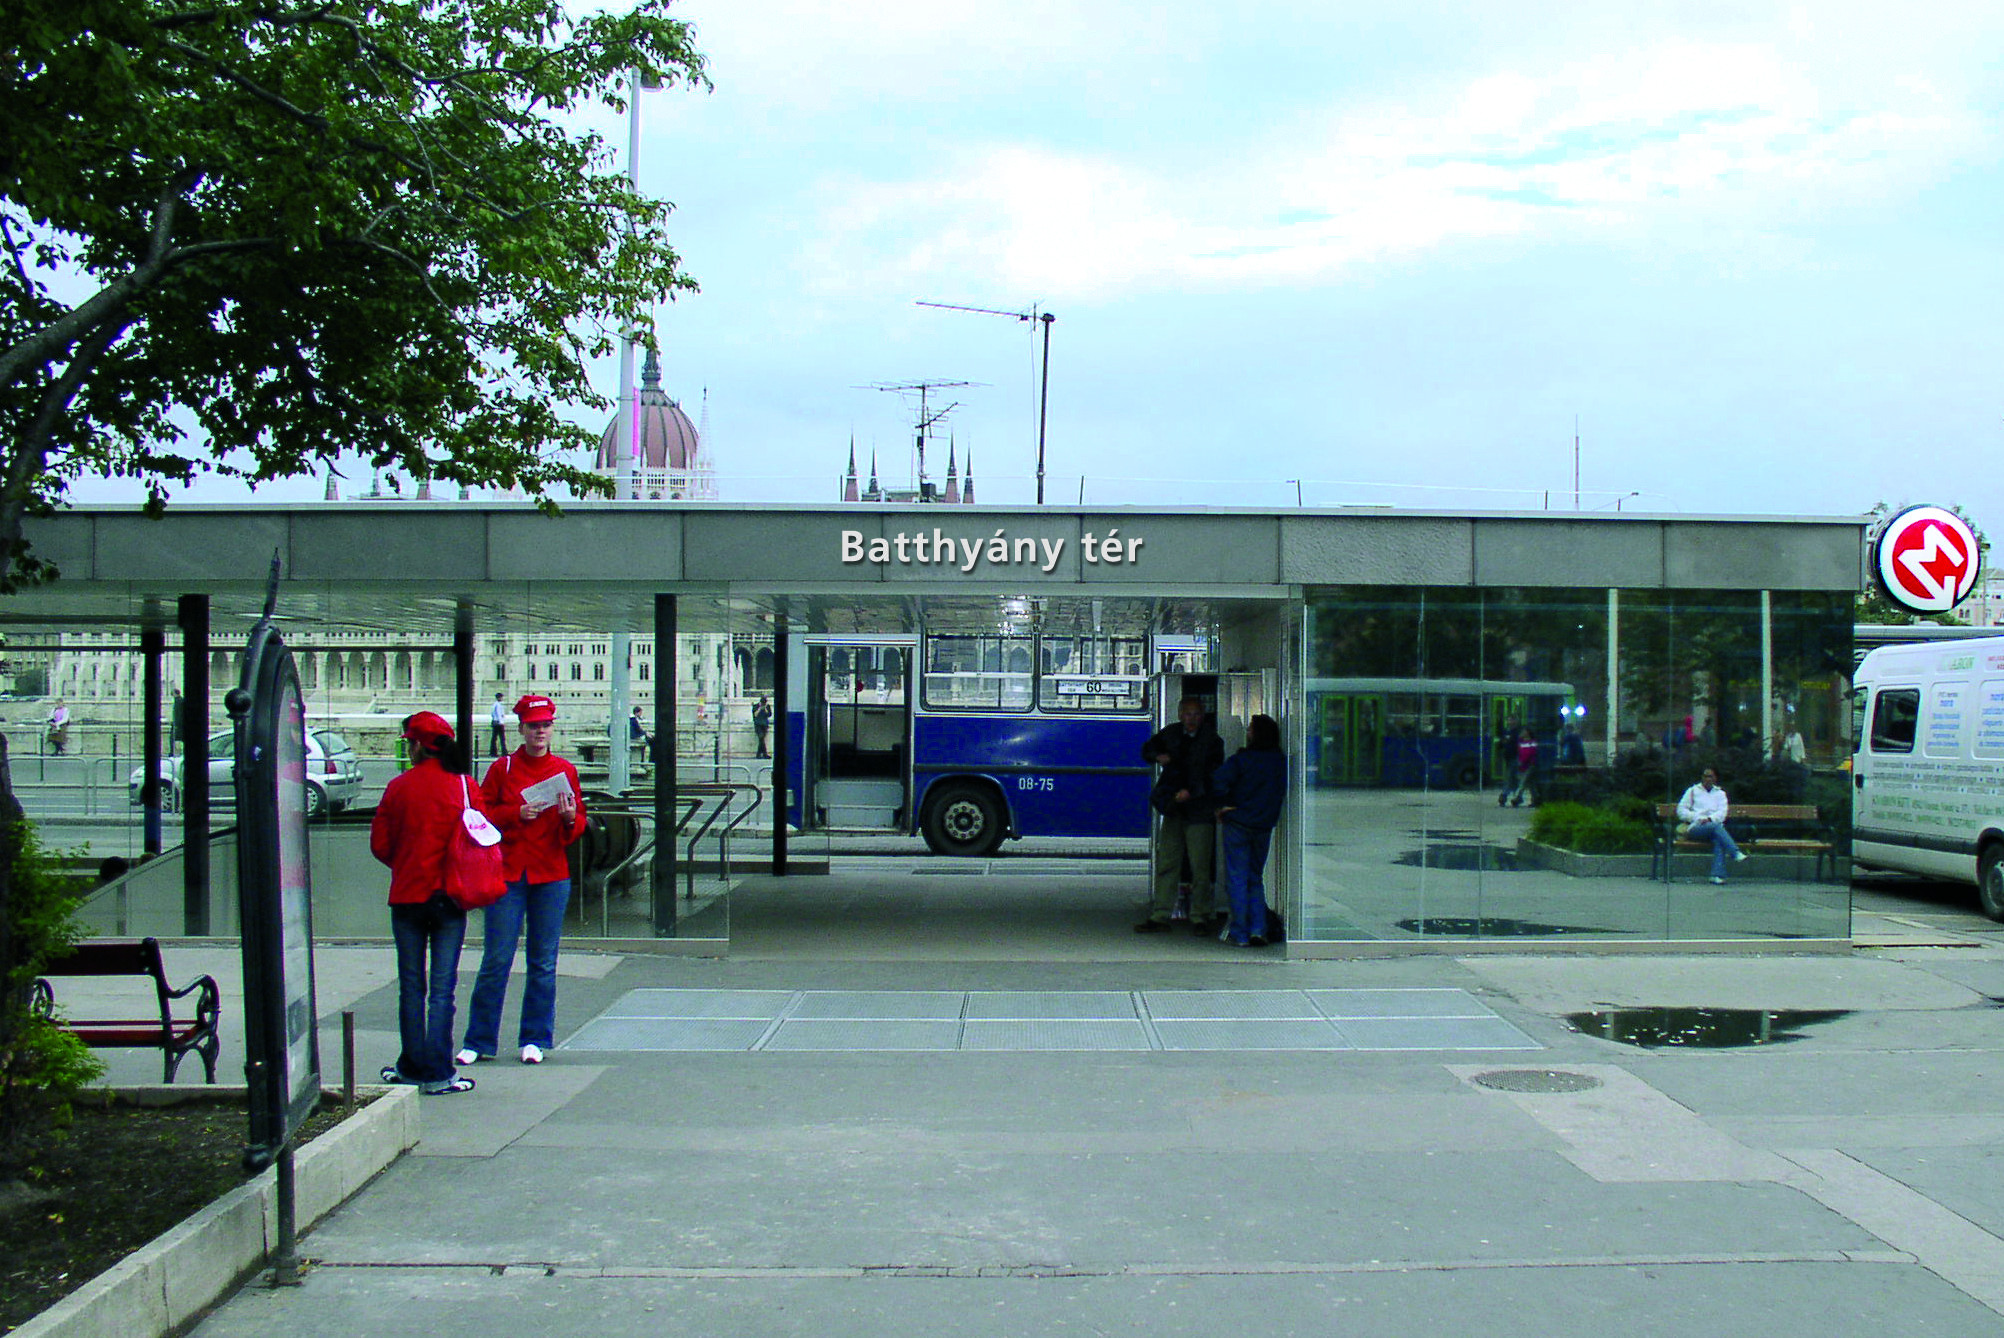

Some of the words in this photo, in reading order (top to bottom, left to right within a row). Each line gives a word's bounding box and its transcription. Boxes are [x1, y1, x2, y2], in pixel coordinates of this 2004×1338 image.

[841, 528, 1065, 571] Batthyány
[1080, 528, 1143, 562] tér
[1086, 681, 1102, 692] 60
[1018, 777, 1054, 791] 08-75
